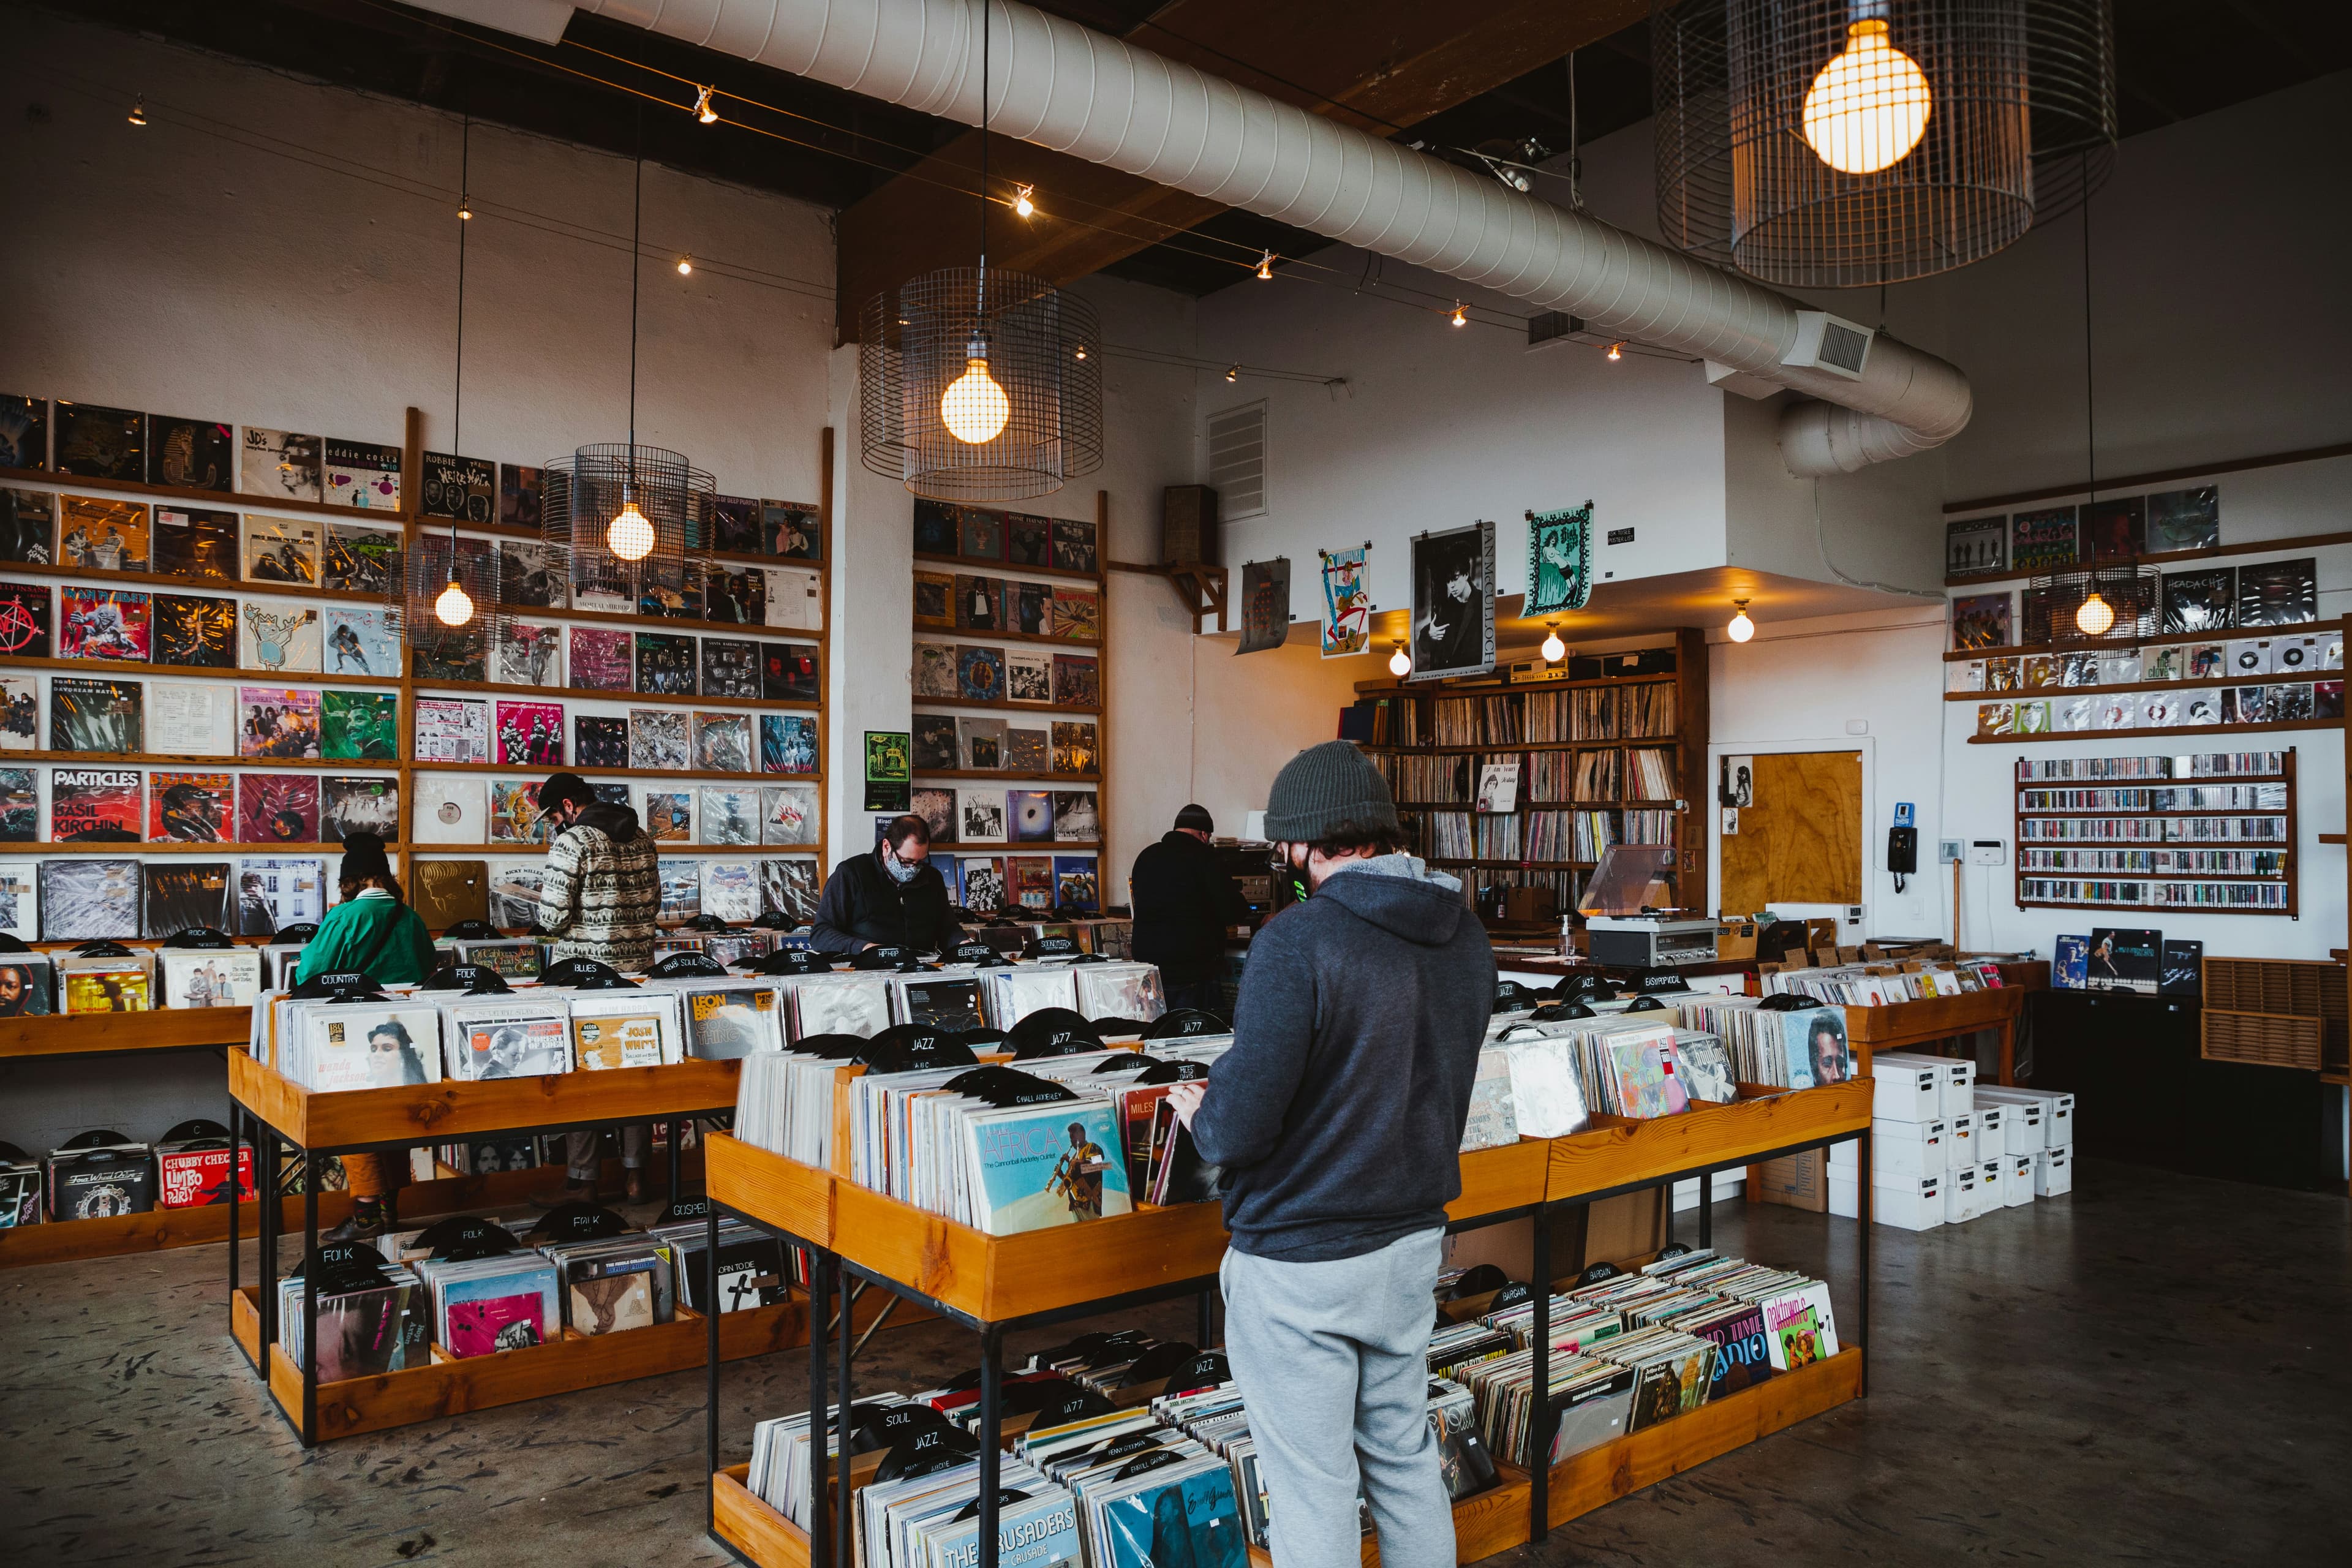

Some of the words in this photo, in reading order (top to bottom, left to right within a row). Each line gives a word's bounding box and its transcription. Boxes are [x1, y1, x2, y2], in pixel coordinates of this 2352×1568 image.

[247, 430, 268, 446] JD's
[328, 448, 359, 459] eddie
[366, 454, 398, 464] costa
[426, 455, 456, 467] ROBBIE
[740, 499, 758, 507] PURPLE
[1484, 527, 1493, 557] IAN
[32, 543, 50, 556] ROCK
[17, 585, 48, 594] INSANE
[2168, 578, 2225, 591] HEADACHE
[64, 587, 94, 602] IRON
[605, 603, 630, 611] MIRROR
[1483, 559, 1494, 665] McCULLOCH
[2157, 657, 2169, 667] the
[2148, 665, 2177, 677] clovers
[54, 771, 140, 787] PARTICLES
[149, 772, 230, 786] BRIDGES
[53, 803, 99, 818] BASIL
[53, 819, 123, 834] KIRCHIN
[519, 948, 536, 957] And
[790, 954, 807, 963] SOUL
[958, 948, 990, 957] ELECTRONIC
[574, 963, 597, 973] BLUES
[680, 958, 698, 967] SOUL
[321, 975, 360, 986] COUNTRY
[456, 970, 477, 979] FOLK
[1582, 977, 1595, 988] JAZZ
[1500, 986, 1513, 997] JAZZ
[692, 994, 726, 1008] LEON
[598, 1005, 619, 1014] SLIM
[622, 1003, 649, 1013] HARPO
[626, 1027, 653, 1037] JOSH
[696, 1029, 740, 1046] THING
[625, 1040, 657, 1050] WHITE
[911, 1038, 935, 1051] JAZZ
[318, 1058, 352, 1073] wanda
[329, 1071, 368, 1085] jackson
[1035, 1091, 1062, 1102] ADDERLEY
[1131, 1101, 1154, 1115] MILES
[193, 1125, 201, 1134] C
[984, 1128, 1063, 1163] AFRICA
[165, 1155, 202, 1170] CHUBBY
[204, 1152, 249, 1166] CHECER
[1019, 1156, 1038, 1165] Adderley
[1038, 1153, 1057, 1163] Quintet
[166, 1168, 203, 1190] LIMBO
[674, 1202, 709, 1216] GOSPEL
[573, 1215, 600, 1227] FOLK
[462, 1228, 484, 1240] FOLK
[323, 1247, 354, 1263] FOLK
[1662, 1249, 1684, 1261] BARGAIN
[718, 1265, 734, 1274] ORN
[735, 1262, 744, 1271] TO
[1589, 1267, 1611, 1281] BARGAIN
[1502, 1286, 1527, 1302] BARGAIN
[1767, 1292, 1809, 1333] oaktown's
[404, 1321, 417, 1345] Axton
[414, 1324, 425, 1343] Hoyt
[1729, 1314, 1764, 1343] TIME
[1712, 1333, 1766, 1382] ADIO
[1195, 1359, 1215, 1374] JAZZ
[886, 1412, 911, 1427] SOUL
[1213, 1412, 1240, 1423] KLEMMER
[914, 1431, 939, 1450] JAZZ
[1150, 1452, 1169, 1466] GARNER
[944, 1542, 979, 1568] THE
[998, 1506, 1076, 1556] RUSADERS
[1010, 1544, 1048, 1567] CRUSADE
